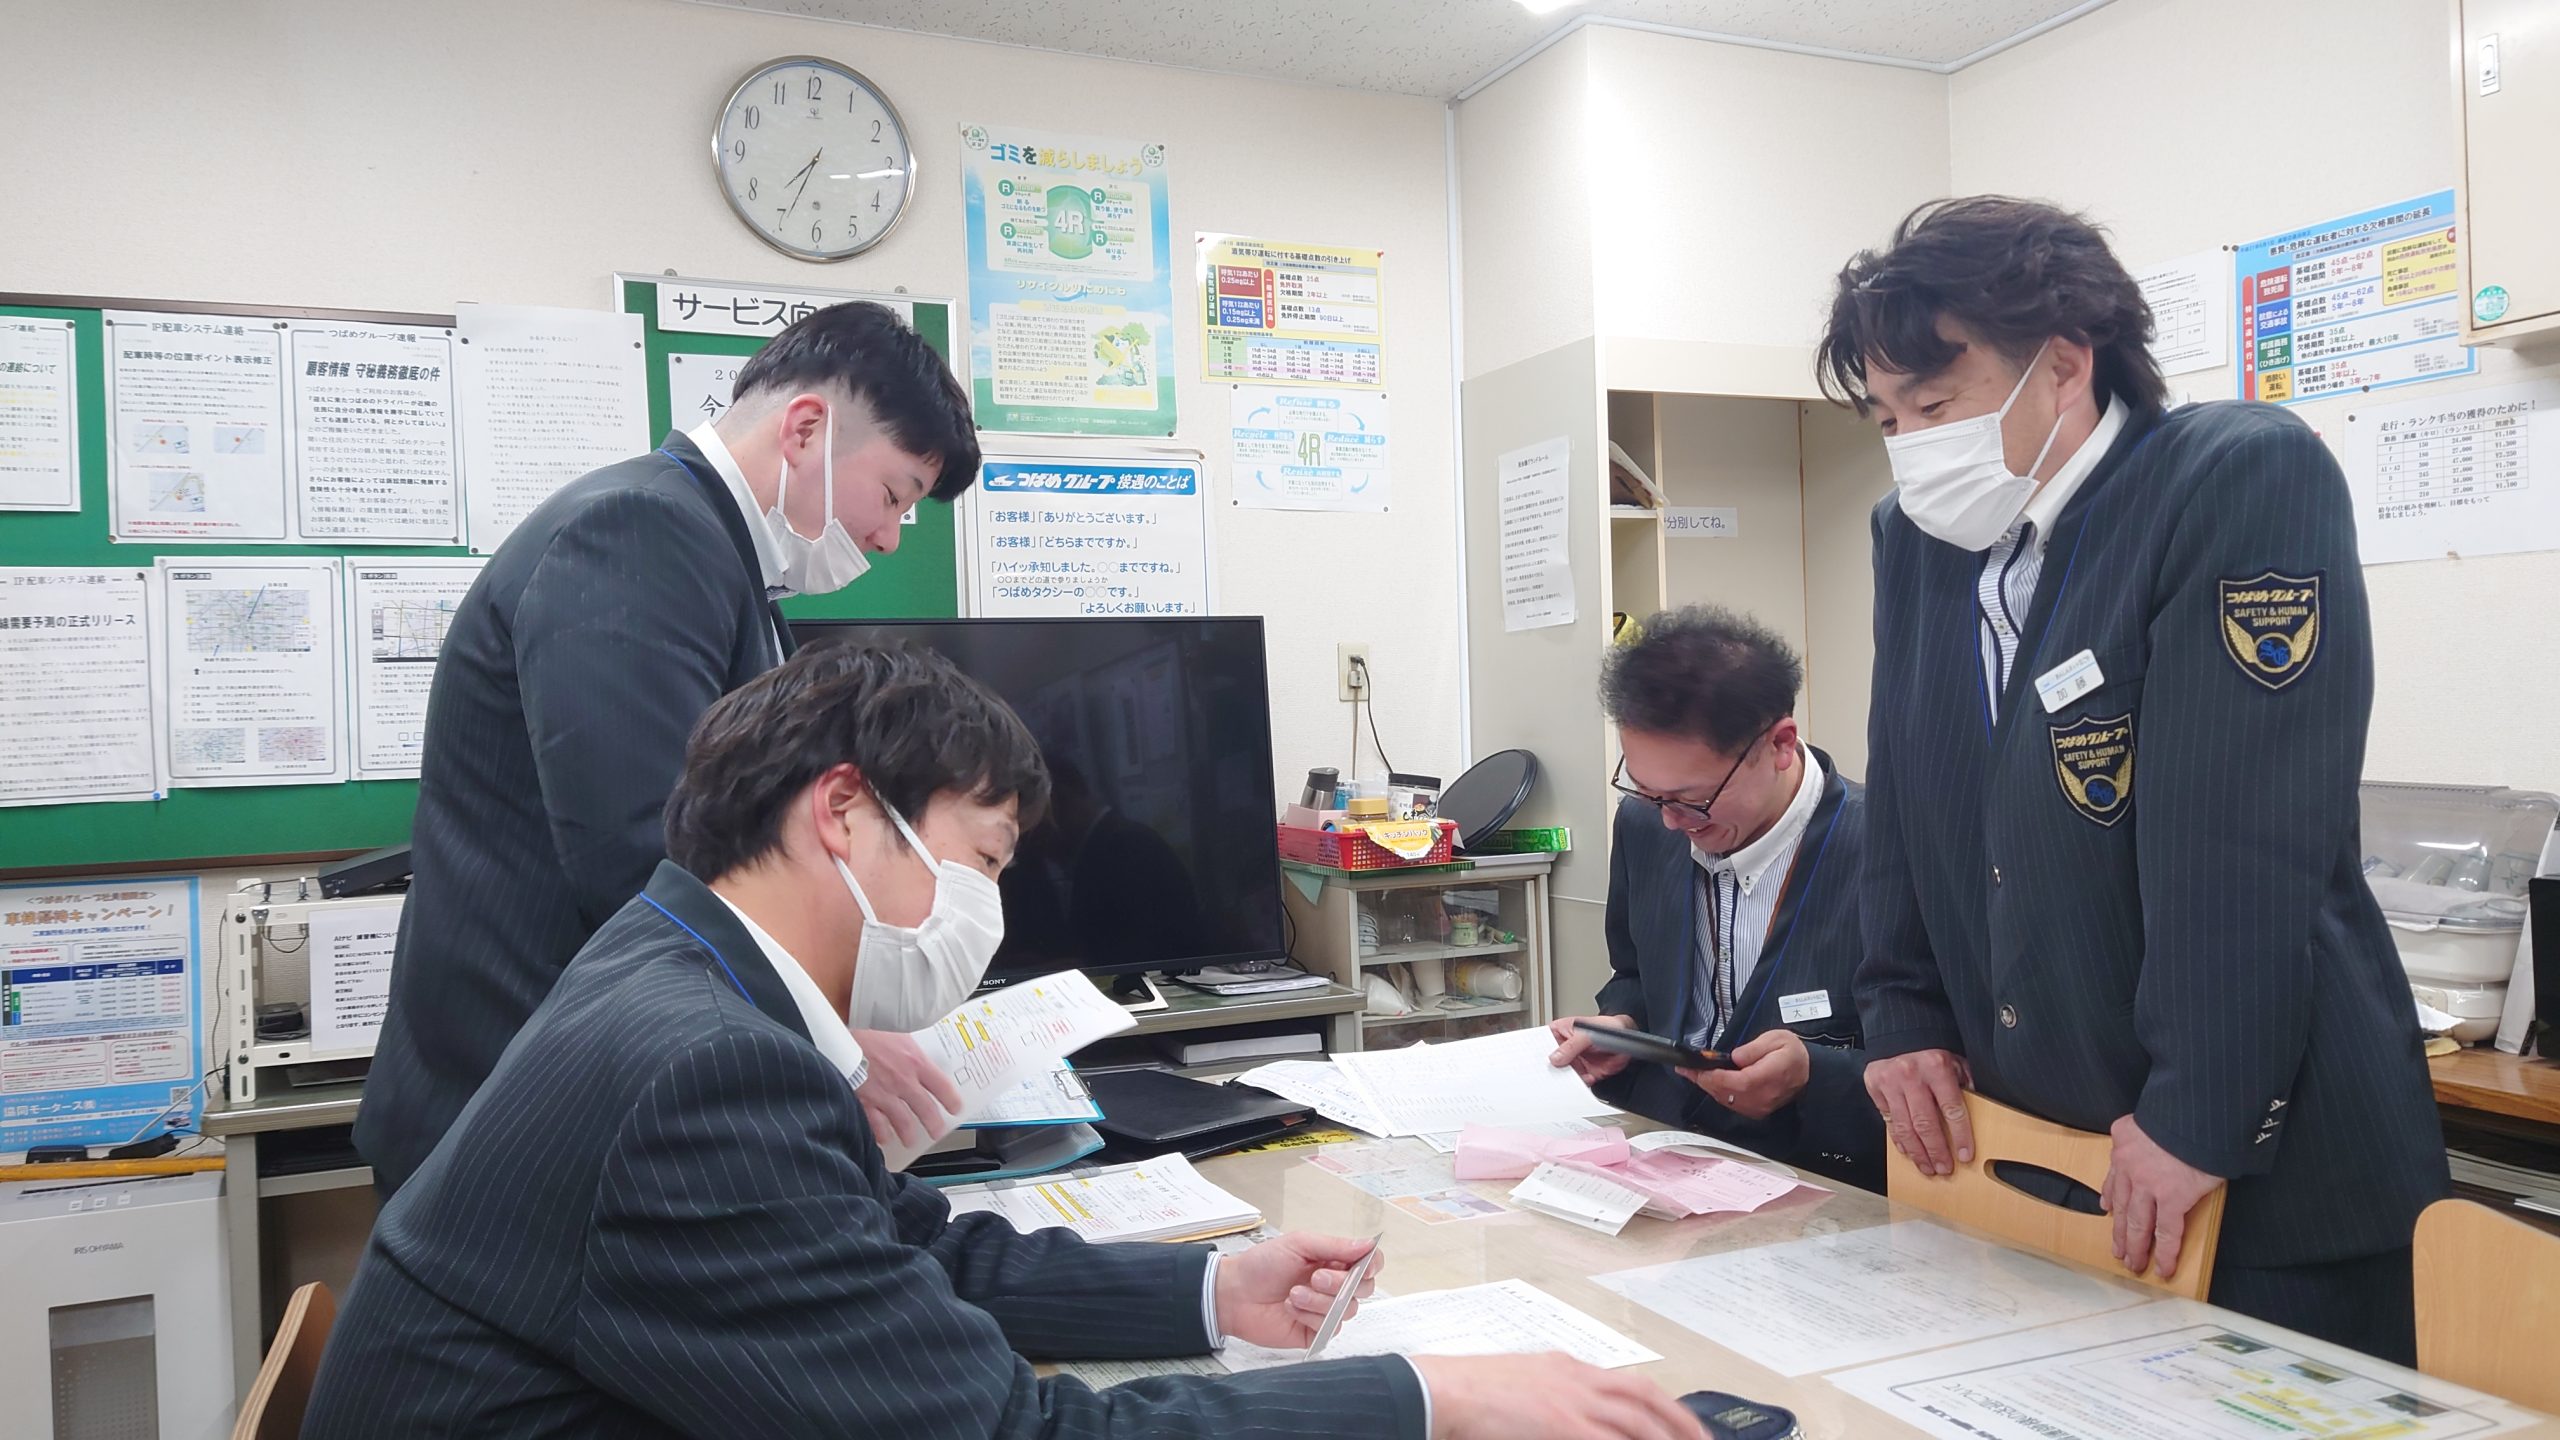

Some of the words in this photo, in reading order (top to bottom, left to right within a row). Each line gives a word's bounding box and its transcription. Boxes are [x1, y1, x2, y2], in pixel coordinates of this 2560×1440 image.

[773, 82, 786, 105] 11
[807, 76, 822, 100] 12
[847, 90, 854, 113] 1
[744, 105, 760, 130] 10
[871, 120, 881, 143] 2
[735, 139, 746, 163] 9
[991, 143, 1143, 177] ゴミを減らしましょう
[748, 177, 758, 201] 8
[871, 190, 881, 212] 4
[777, 208, 787, 231] 7
[811, 219, 822, 243] 6
[848, 215, 858, 238] 5
[1298, 431, 1321, 466] 4R
[989, 511, 1158, 525] 「お客様」「ありがとうございます。」
[1664, 515, 1727, 530] 分別してね。
[989, 536, 1139, 549] 「お客様」「どちらまでですか。」
[1079, 602, 1196, 614] 「よろしくお願いします。」
[2233, 607, 2268, 619] SAFETY
[2278, 605, 2308, 617] HUMAN
[2252, 615, 2293, 627] SUPPORT
[2063, 749, 2088, 762] SAFETY
[2096, 744, 2125, 757] HUMAN
[2078, 757, 2110, 770] SUPPORT
[982, 978, 1007, 987] SONY
